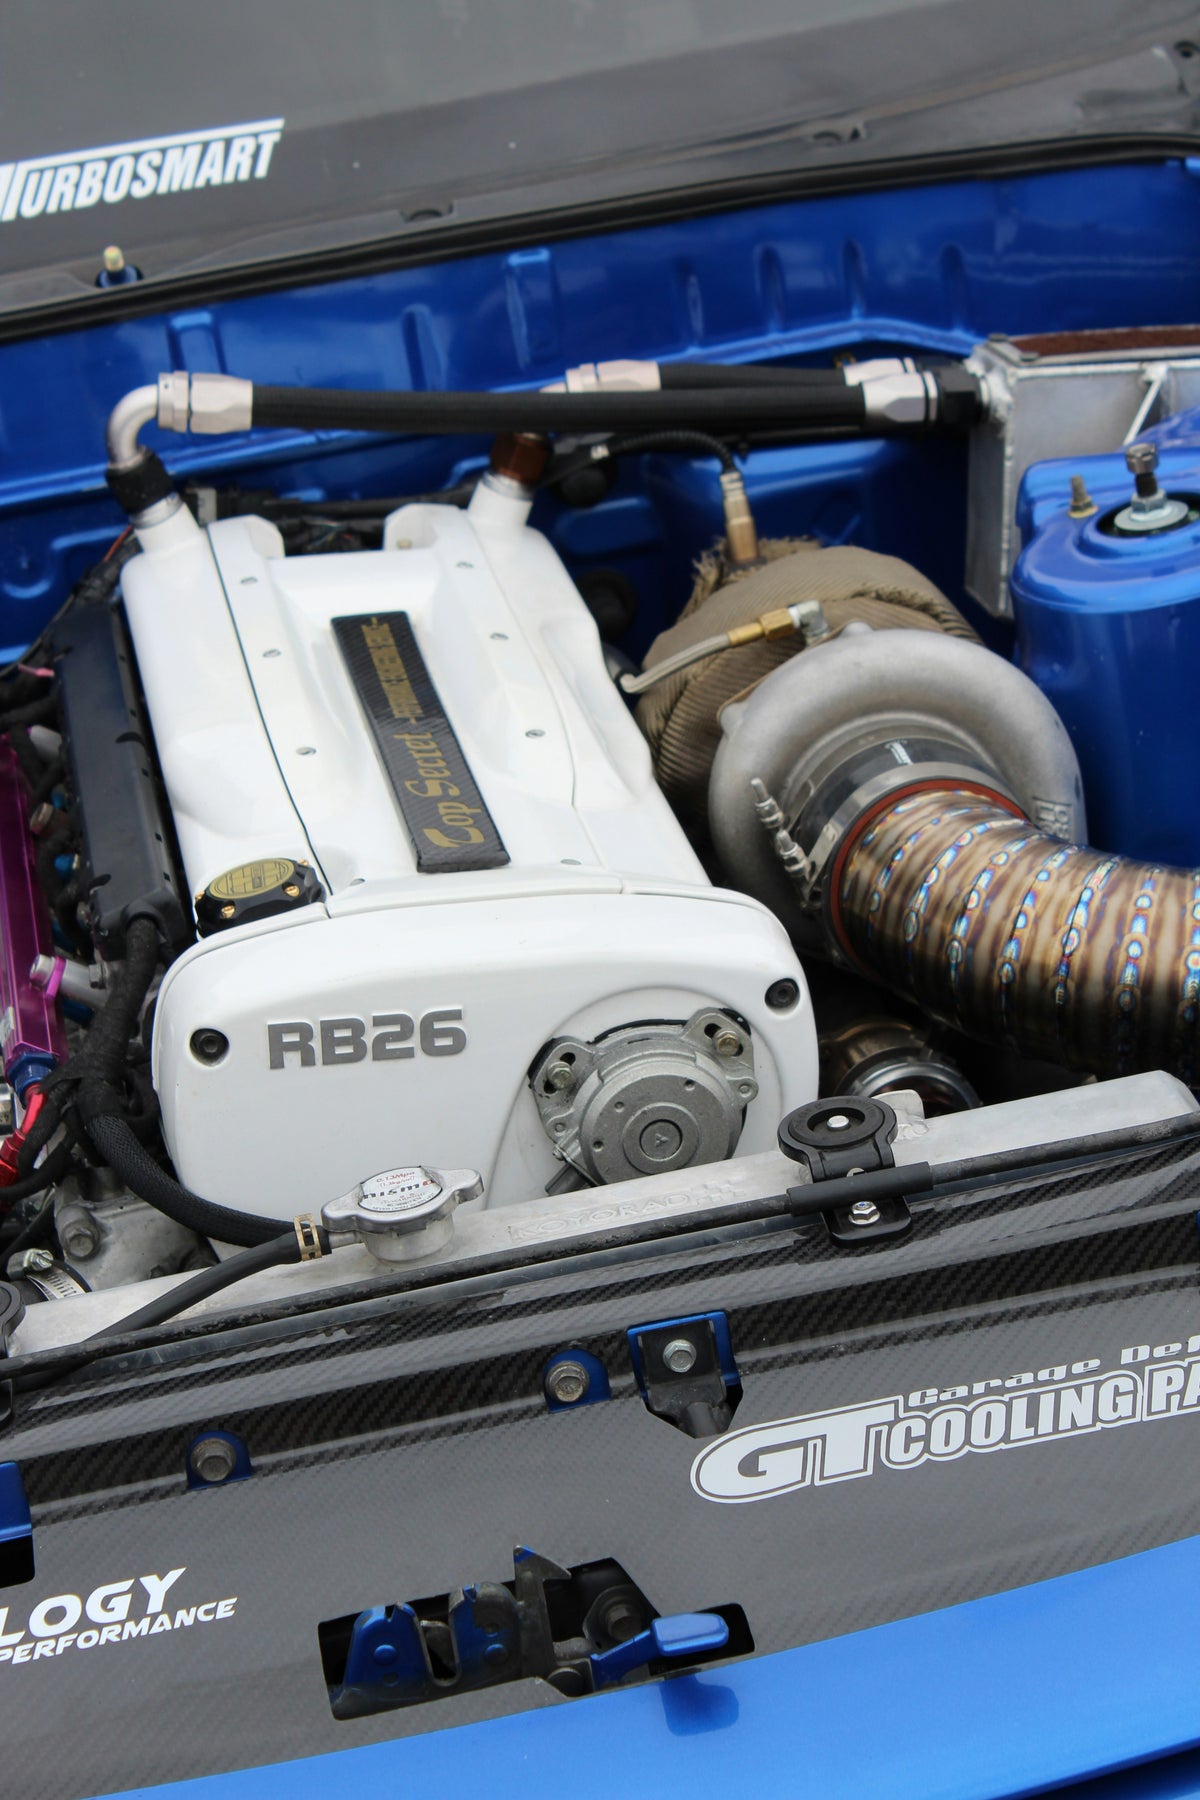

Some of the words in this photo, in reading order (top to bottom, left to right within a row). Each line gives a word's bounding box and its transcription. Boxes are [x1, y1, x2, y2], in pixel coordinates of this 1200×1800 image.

[0, 117, 285, 222] TURBOSMART
[393, 731, 461, 797] Secret
[423, 801, 485, 848] Top
[267, 1007, 467, 1070] RB26
[510, 1193, 690, 1242] KOYORAD
[908, 1358, 1101, 1408] Garage
[692, 1397, 902, 1502] GT
[886, 1376, 1136, 1465] COOLING
